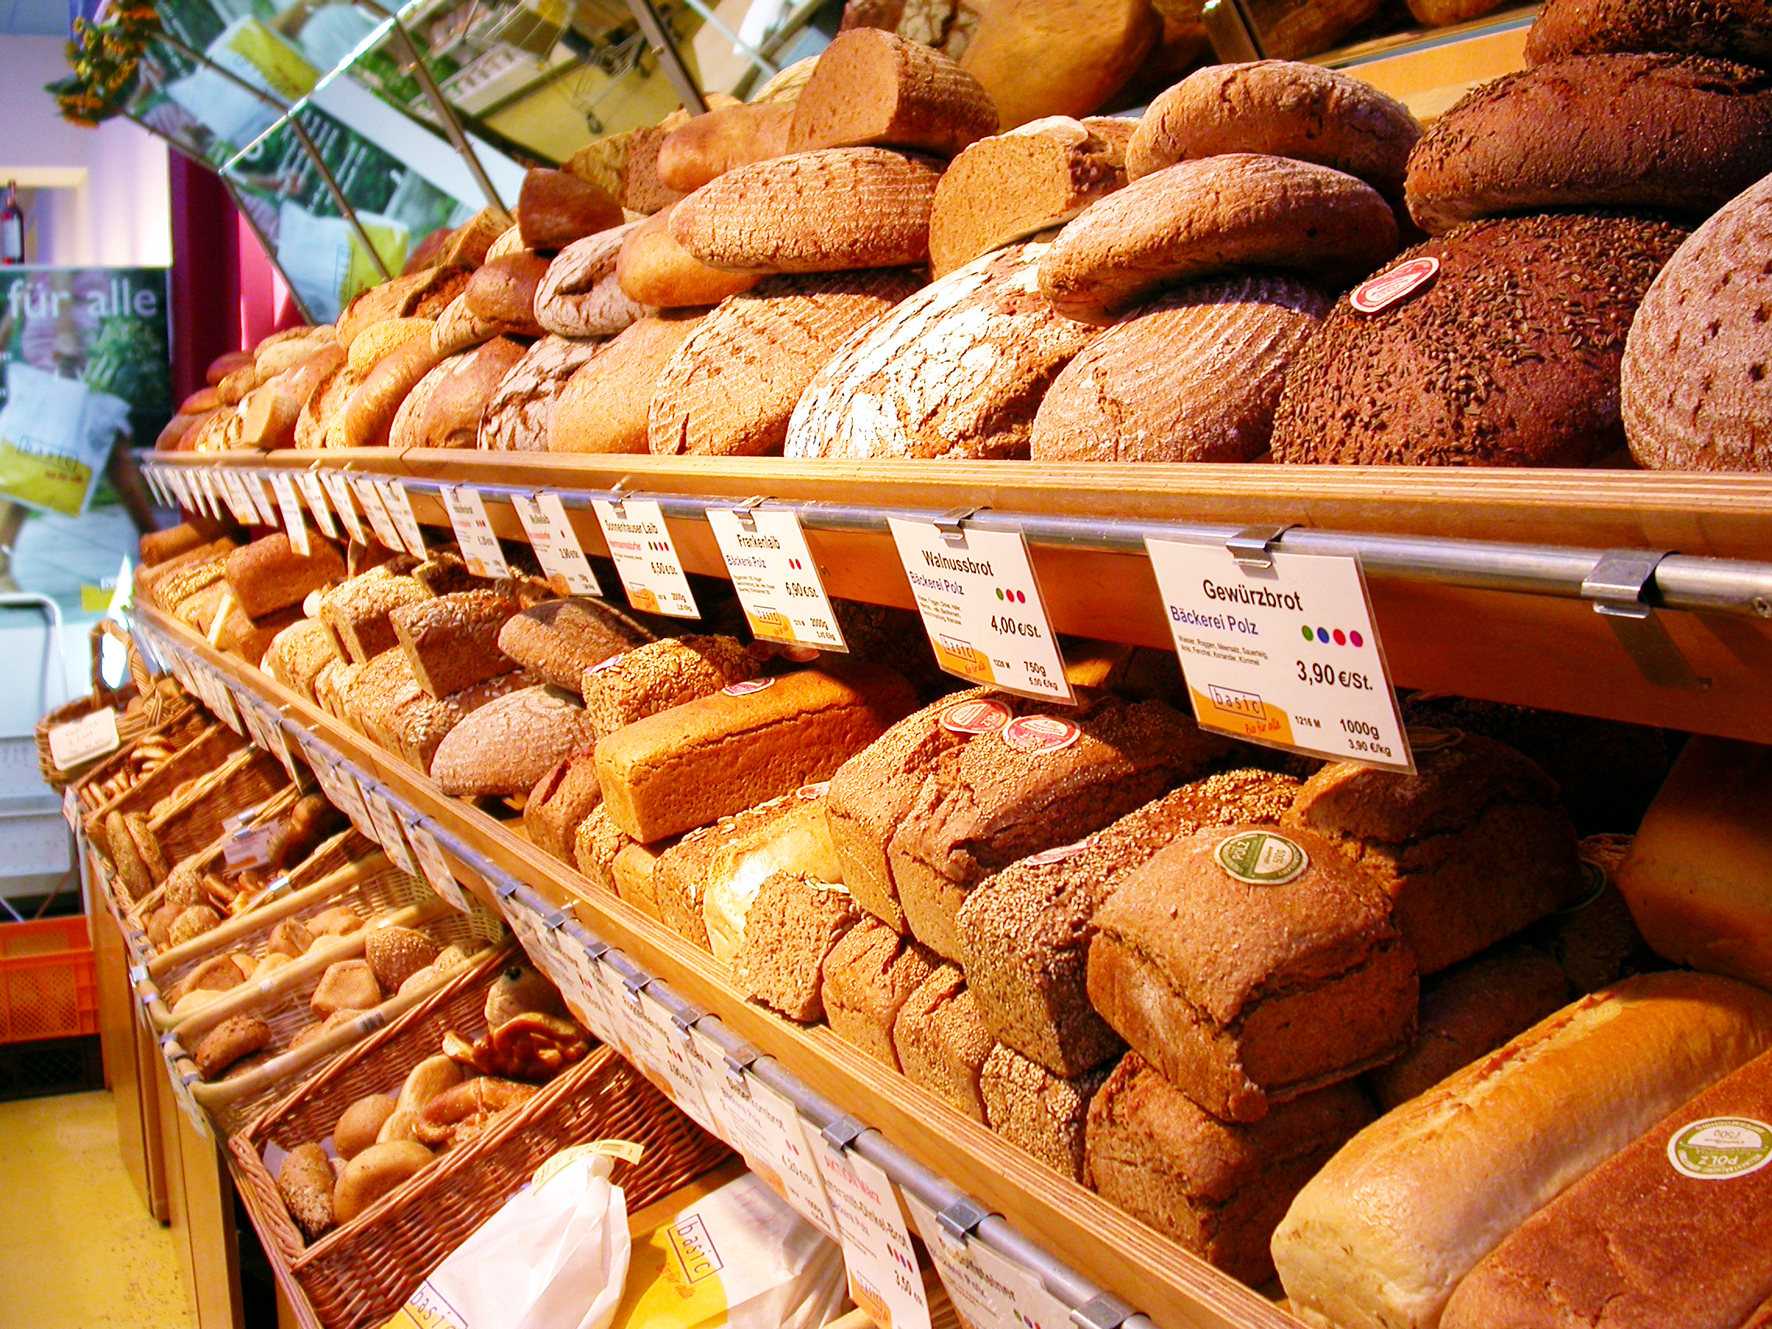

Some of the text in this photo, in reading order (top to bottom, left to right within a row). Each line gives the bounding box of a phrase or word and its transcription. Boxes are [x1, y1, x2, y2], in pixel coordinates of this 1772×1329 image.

[8, 277, 157, 320] für alle
[737, 534, 781, 549] Frankenlaib
[752, 556, 767, 569] Polz
[922, 549, 994, 577] Walnussbrot
[785, 581, 803, 598] 6,90
[909, 571, 965, 595] Bäckerei Polz
[1203, 579, 1304, 611] Gewürzbrot
[991, 615, 1042, 638] 4,00 €/St.
[1170, 605, 1259, 635] Bäckerei Polz
[1023, 660, 1046, 677] 750g
[1296, 660, 1374, 690] 3,90 €/St.
[1213, 688, 1260, 714] basic
[1313, 719, 1321, 729] M
[1340, 718, 1379, 740] 1000g
[1348, 738, 1391, 757] 3,90 €/kg
[1232, 841, 1251, 860] POLZ
[1698, 1155, 1739, 1166] POLZ
[677, 1220, 712, 1273] basic
[410, 1285, 456, 1329] basi
